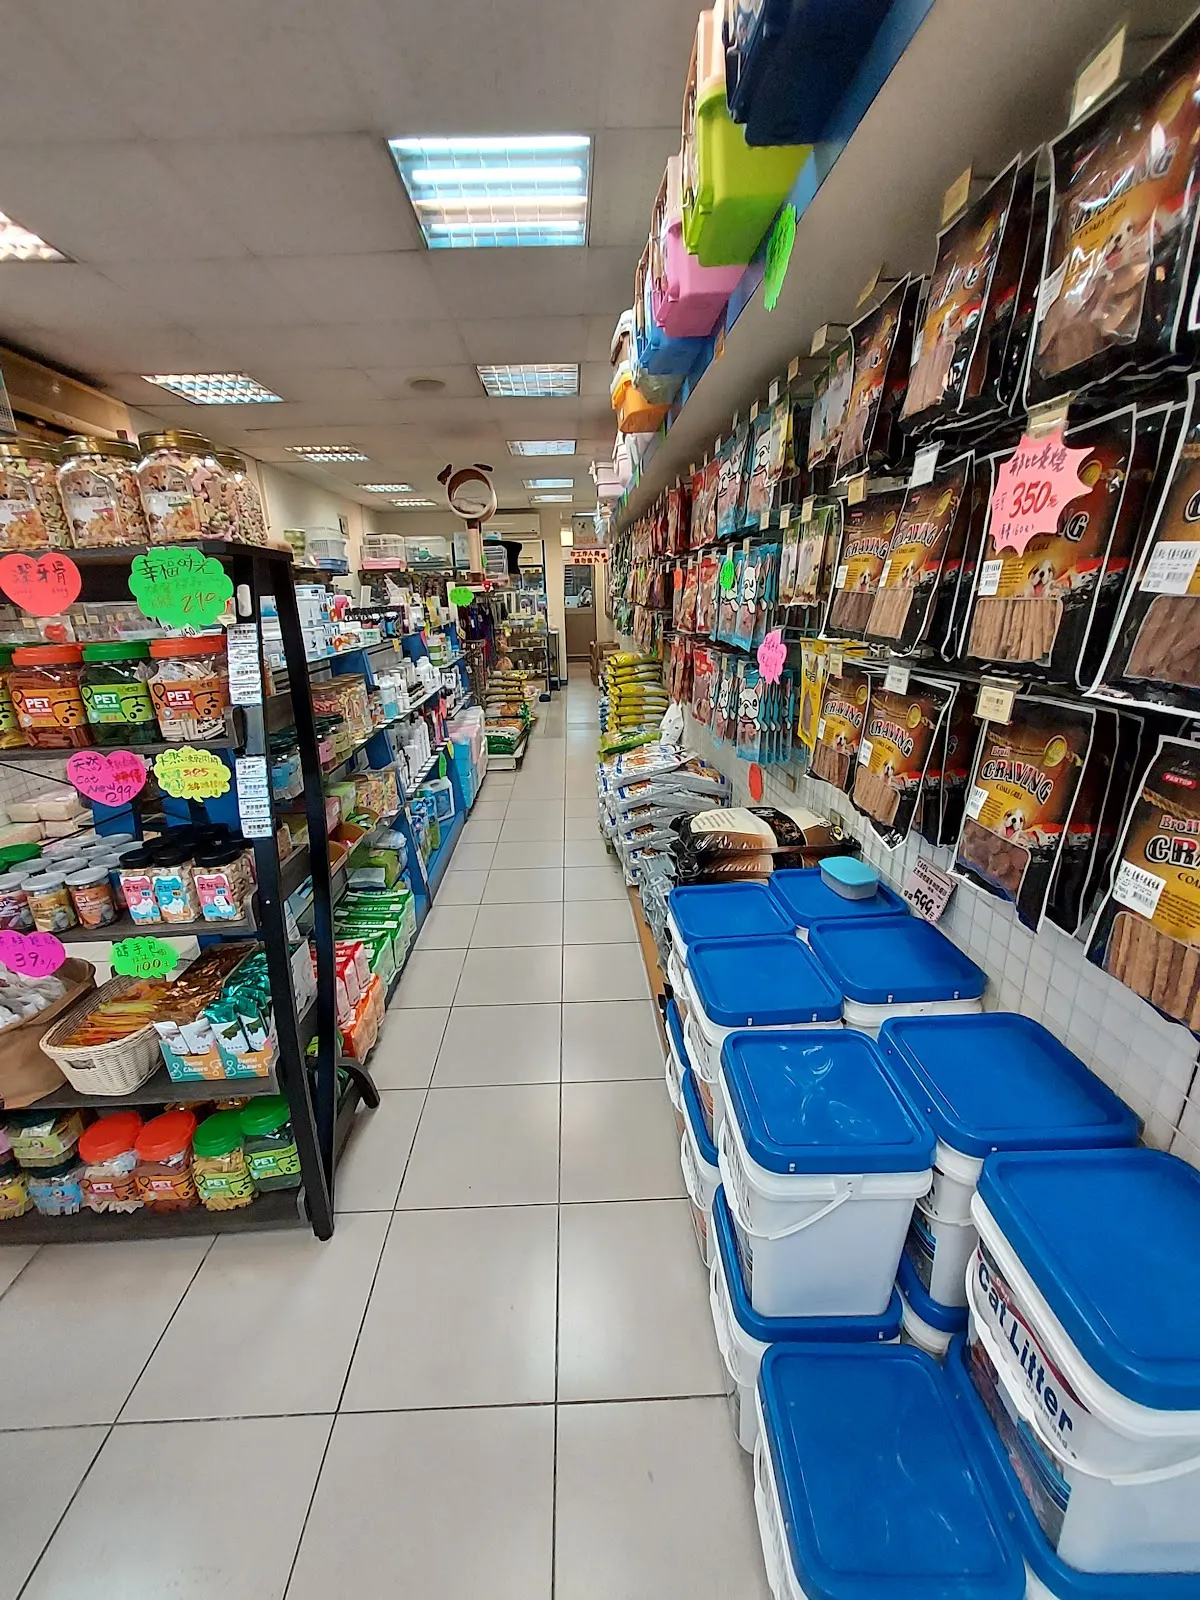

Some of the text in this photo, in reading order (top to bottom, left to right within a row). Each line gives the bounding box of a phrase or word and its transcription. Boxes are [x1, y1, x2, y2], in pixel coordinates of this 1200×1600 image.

[93, 693, 117, 704] PET
[166, 690, 191, 702] PET
[24, 698, 50, 709] PET
[76, 774, 99, 785] Cat
[981, 759, 1054, 806] CRAVING
[105, 785, 132, 803] 299
[237, 1063, 262, 1071] Chews
[254, 1157, 275, 1167] PET
[92, 1183, 114, 1191] PET
[151, 1180, 172, 1190] PET
[206, 1178, 227, 1188] PET
[978, 1262, 1073, 1433] Cat Litter
